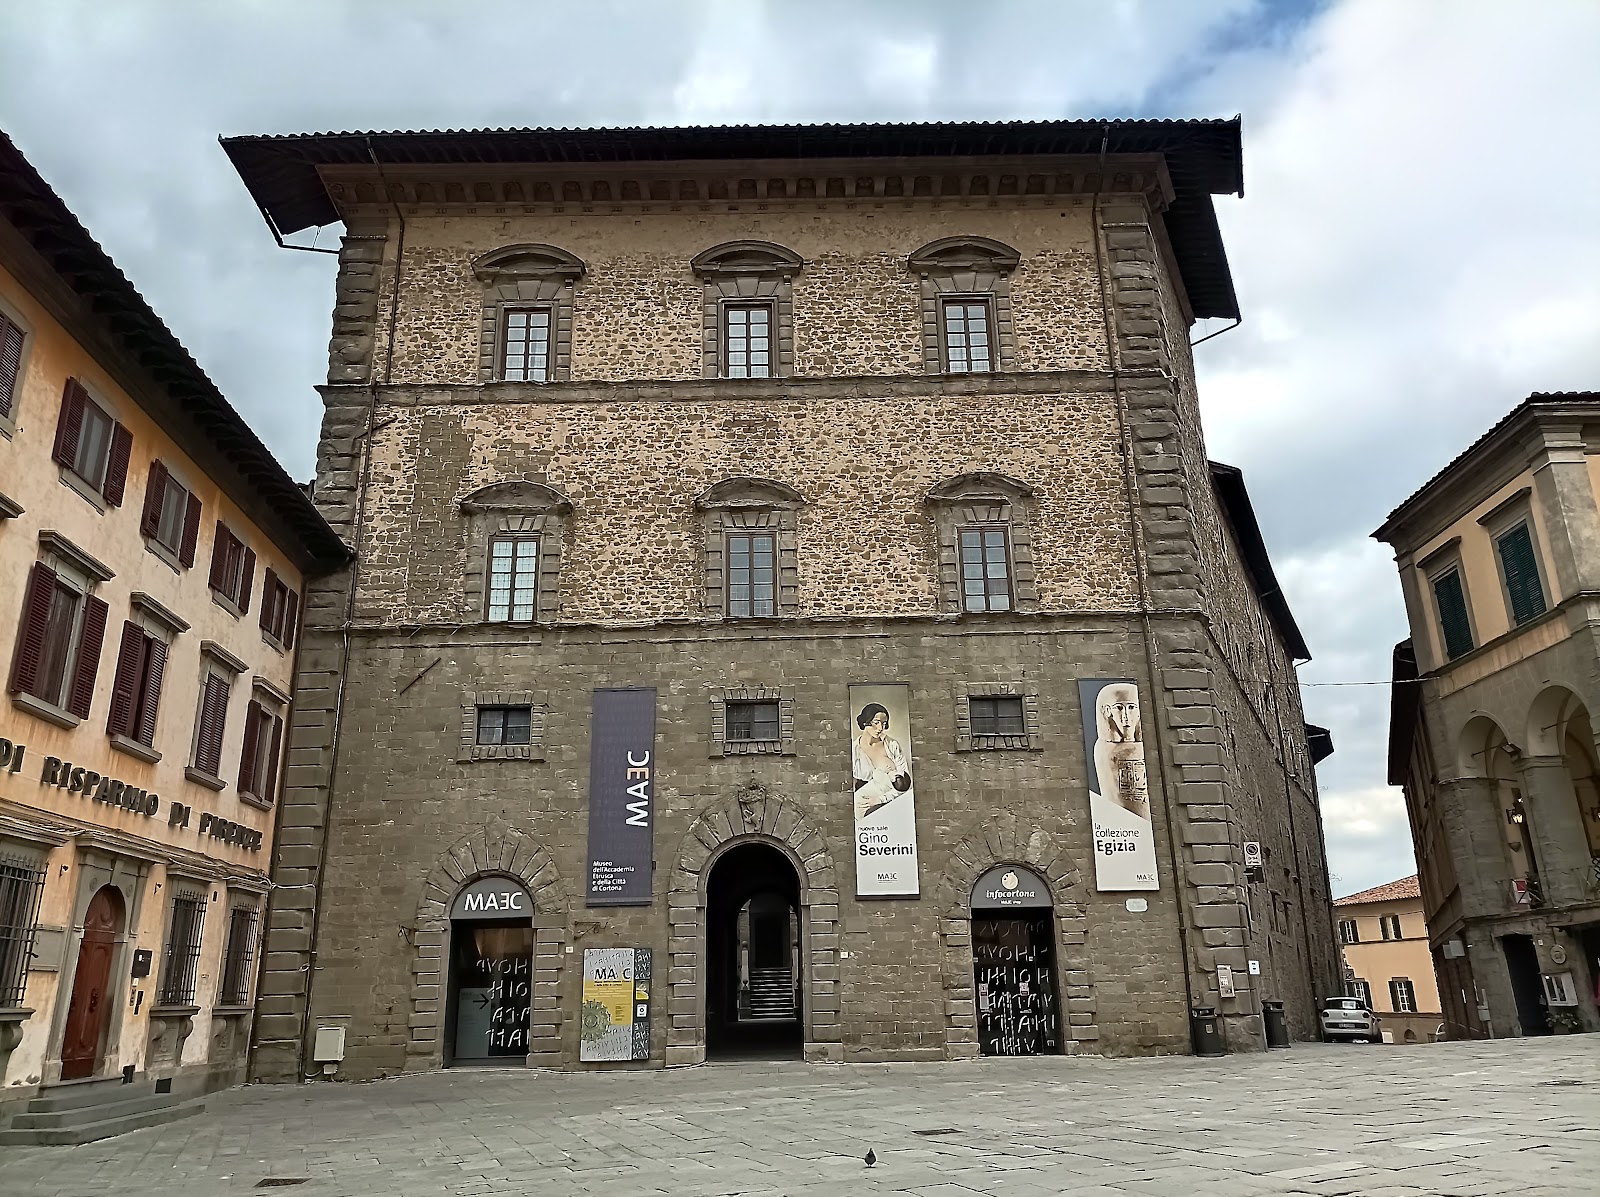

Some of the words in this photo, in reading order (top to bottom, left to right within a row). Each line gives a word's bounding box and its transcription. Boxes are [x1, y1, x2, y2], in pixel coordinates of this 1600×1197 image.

[0, 737, 26, 772] DI
[41, 756, 159, 816] RISPARMIO
[168, 802, 191, 828] DI
[199, 812, 263, 851] FIRENZE
[1094, 822, 1101, 830] la
[858, 832, 889, 844] Gino
[1095, 828, 1140, 838] collezione
[859, 844, 913, 856] Severini
[1096, 840, 1136, 856] Egizia
[986, 889, 1036, 900] infocortona
[594, 967, 631, 980] MAC
